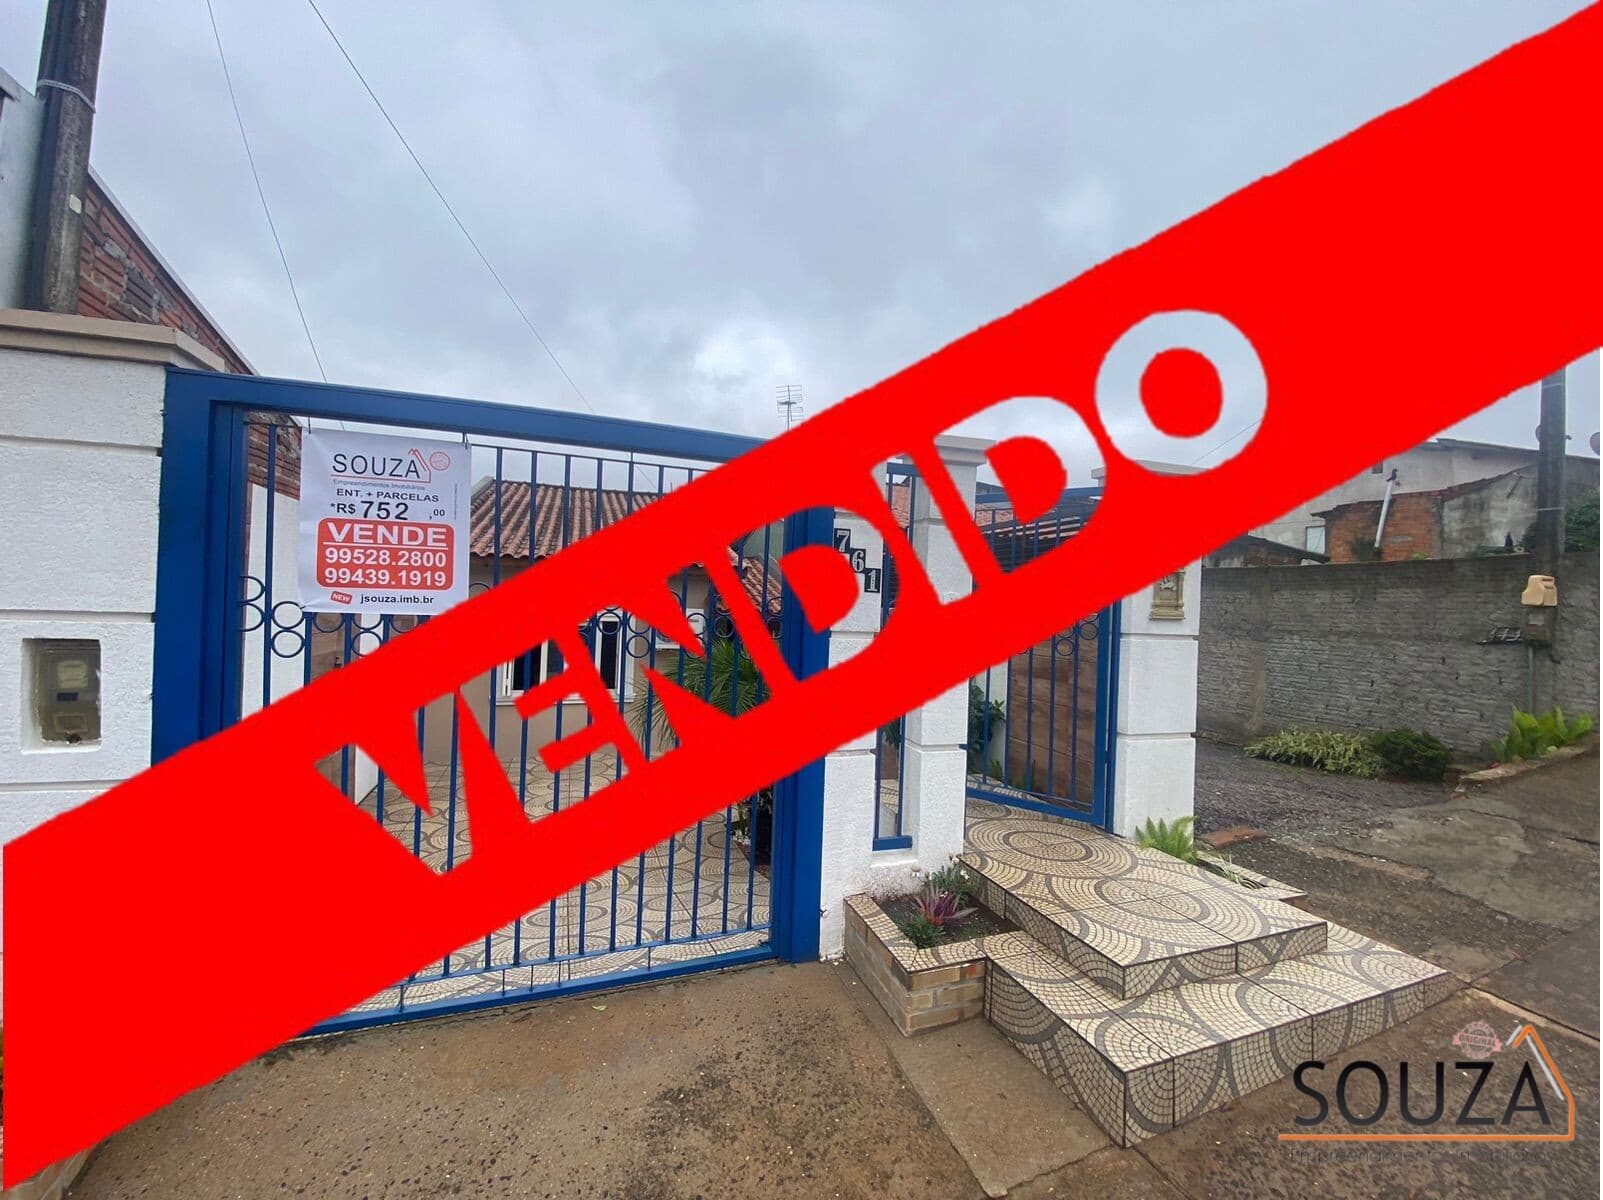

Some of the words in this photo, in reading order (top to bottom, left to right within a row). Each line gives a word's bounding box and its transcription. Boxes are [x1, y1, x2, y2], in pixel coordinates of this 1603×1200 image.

[332, 454, 420, 478] SOUZA
[336, 488, 363, 498] ENT.
[376, 491, 439, 502] PARCELAS
[360, 500, 409, 521] 752
[327, 523, 447, 546] VENDE
[325, 547, 447, 568] 99528.2800
[324, 568, 447, 586] 99439.1919
[360, 594, 434, 604] jsouza.imb.br
